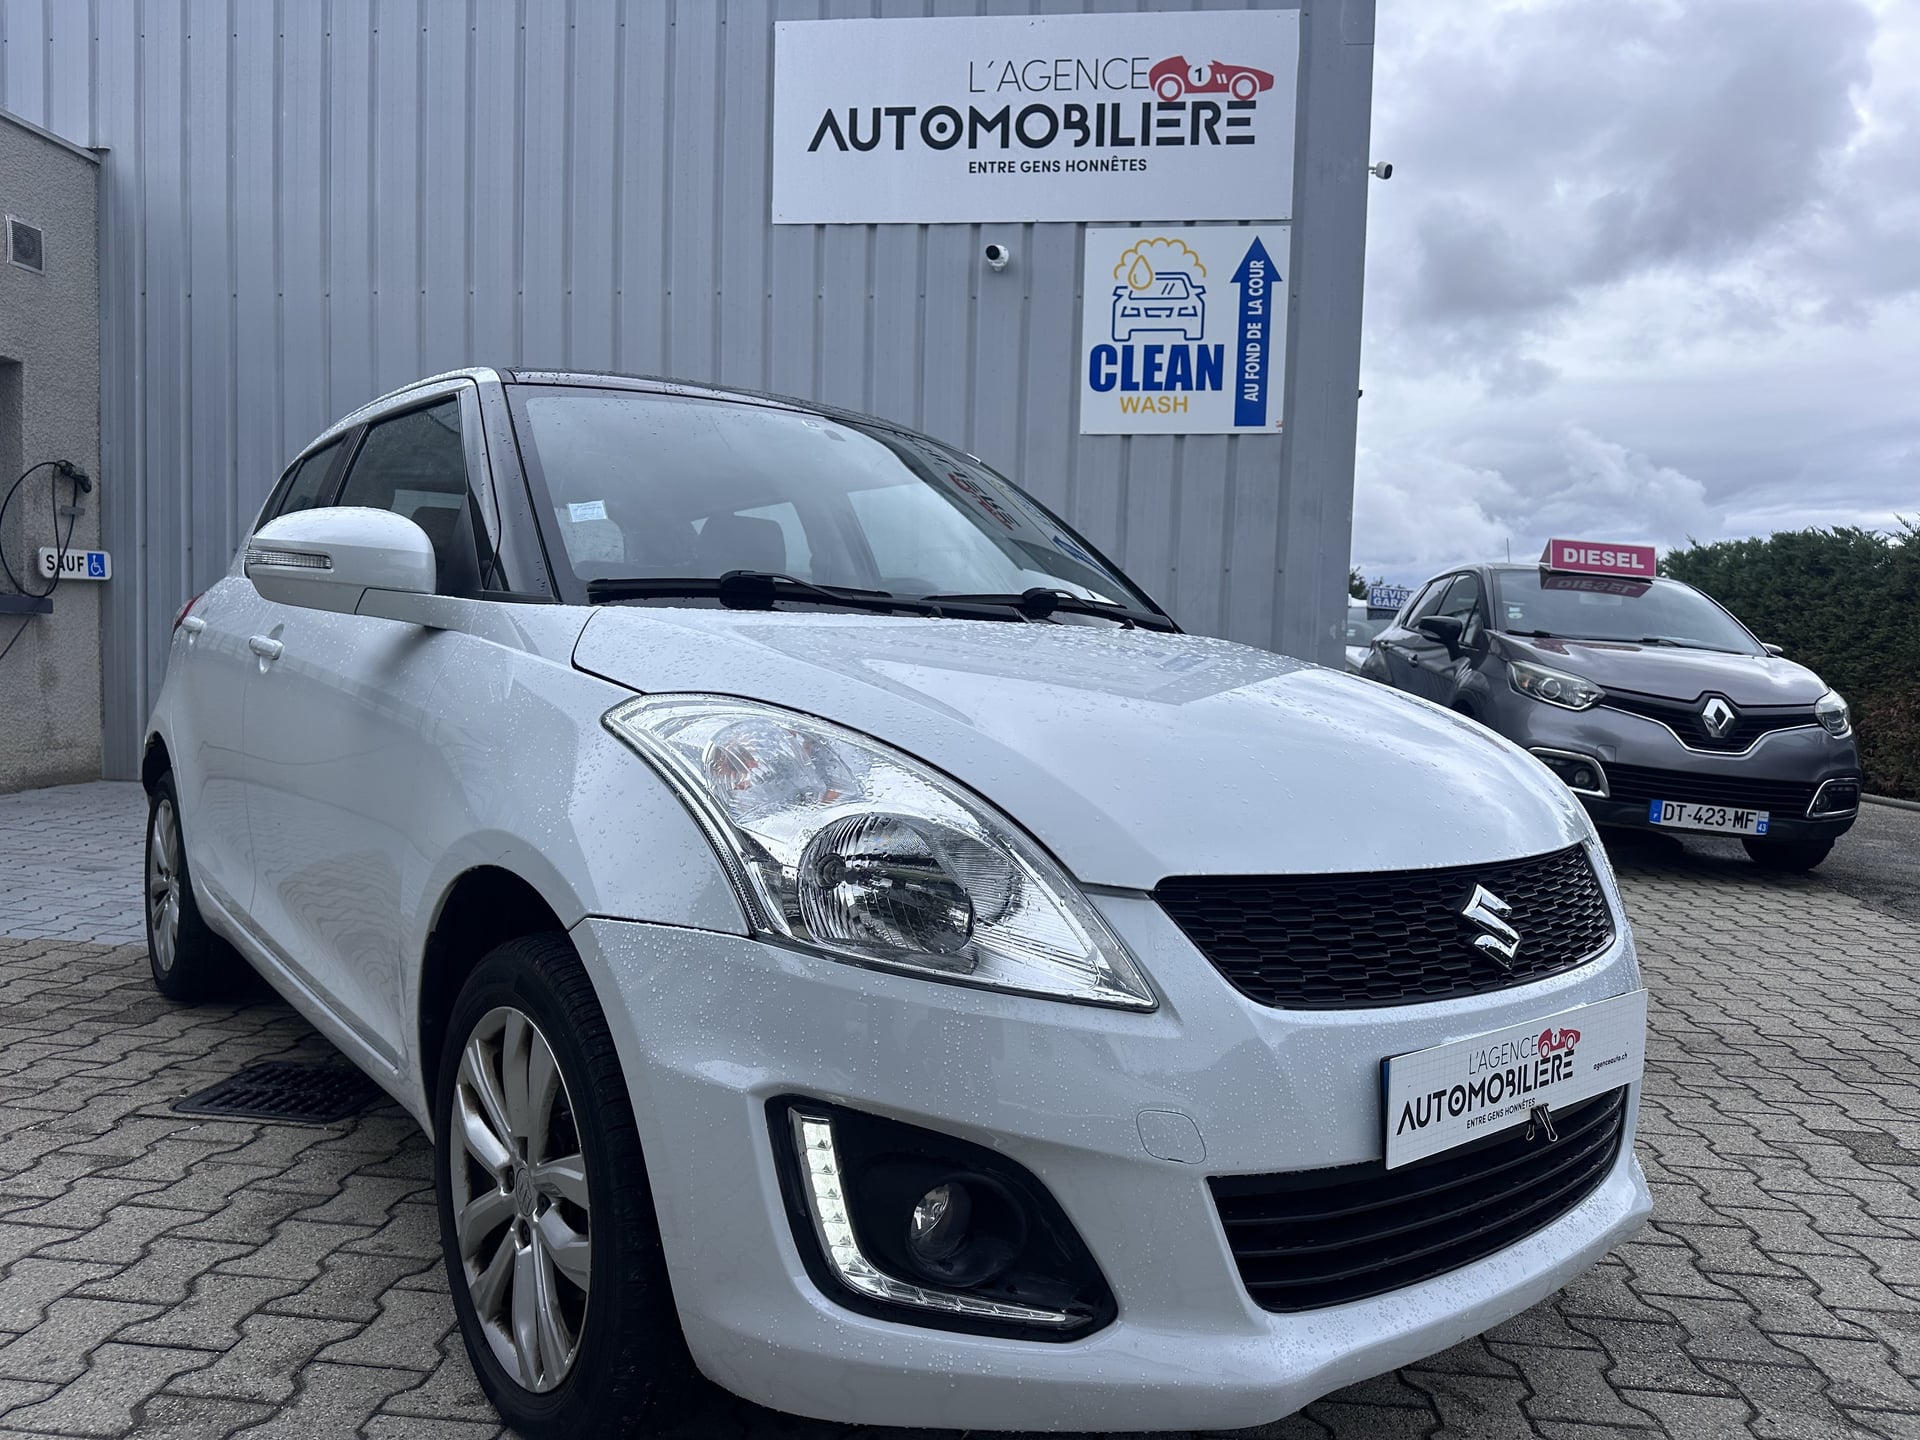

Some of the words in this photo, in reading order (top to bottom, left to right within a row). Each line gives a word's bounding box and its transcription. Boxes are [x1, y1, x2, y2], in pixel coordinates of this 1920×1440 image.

[969, 57, 1149, 93] L'AGENCE
[1194, 68, 1203, 83] 1
[968, 160, 1016, 174] ENTRE
[1020, 159, 1061, 173] GENS
[1065, 155, 1147, 173] HONNÊTES
[1248, 260, 1264, 297] COUR
[1247, 299, 1263, 315] LA
[1247, 322, 1262, 339] DE
[1089, 344, 1224, 392] CLEAN
[1245, 342, 1261, 379] FOND
[1243, 383, 1259, 402] AU
[1120, 395, 1188, 414] WASH
[46, 554, 84, 572] SAUF
[1563, 547, 1645, 568] DIESEL
[1372, 588, 1411, 601] REVIS
[1663, 803, 1757, 830] DT-423-MF
[1469, 1034, 1539, 1075] L'AGENCE
[1466, 1114, 1487, 1129] ENTRE
[1487, 1108, 1504, 1122] GENS
